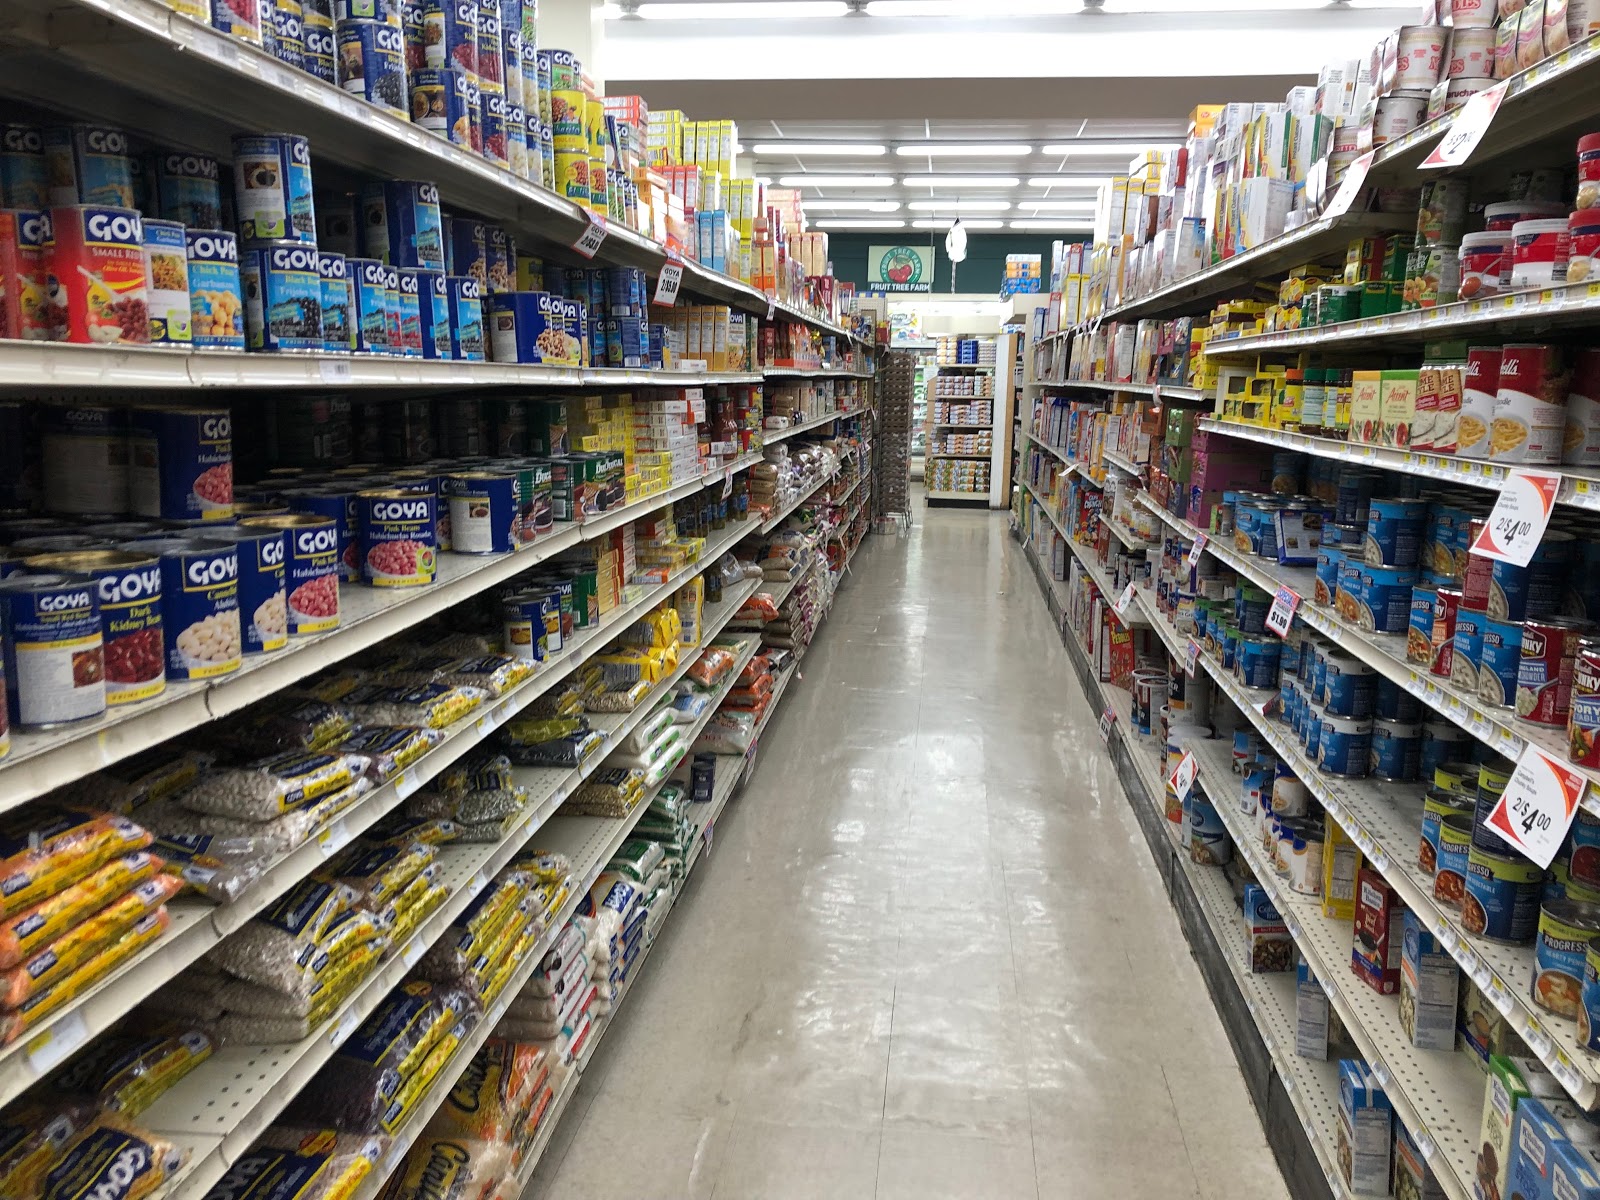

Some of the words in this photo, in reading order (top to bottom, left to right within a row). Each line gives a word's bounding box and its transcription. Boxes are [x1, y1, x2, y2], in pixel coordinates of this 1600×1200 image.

[477, 17, 499, 34] GO
[166, 155, 219, 178] GOYA
[590, 226, 606, 237] GOYA
[664, 267, 680, 277] GOYA
[870, 283, 890, 291] FRUIT
[892, 283, 910, 291] TREE
[910, 283, 930, 291] FARM
[372, 501, 428, 520] GOYA
[384, 524, 399, 532] Pink
[401, 524, 420, 532] Beans
[40, 592, 90, 611] GOYA
[130, 607, 152, 617] Dark
[110, 618, 144, 632] Kidney
[1271, 611, 1288, 629] $1.99
[1517, 769, 1535, 785] Campbell's
